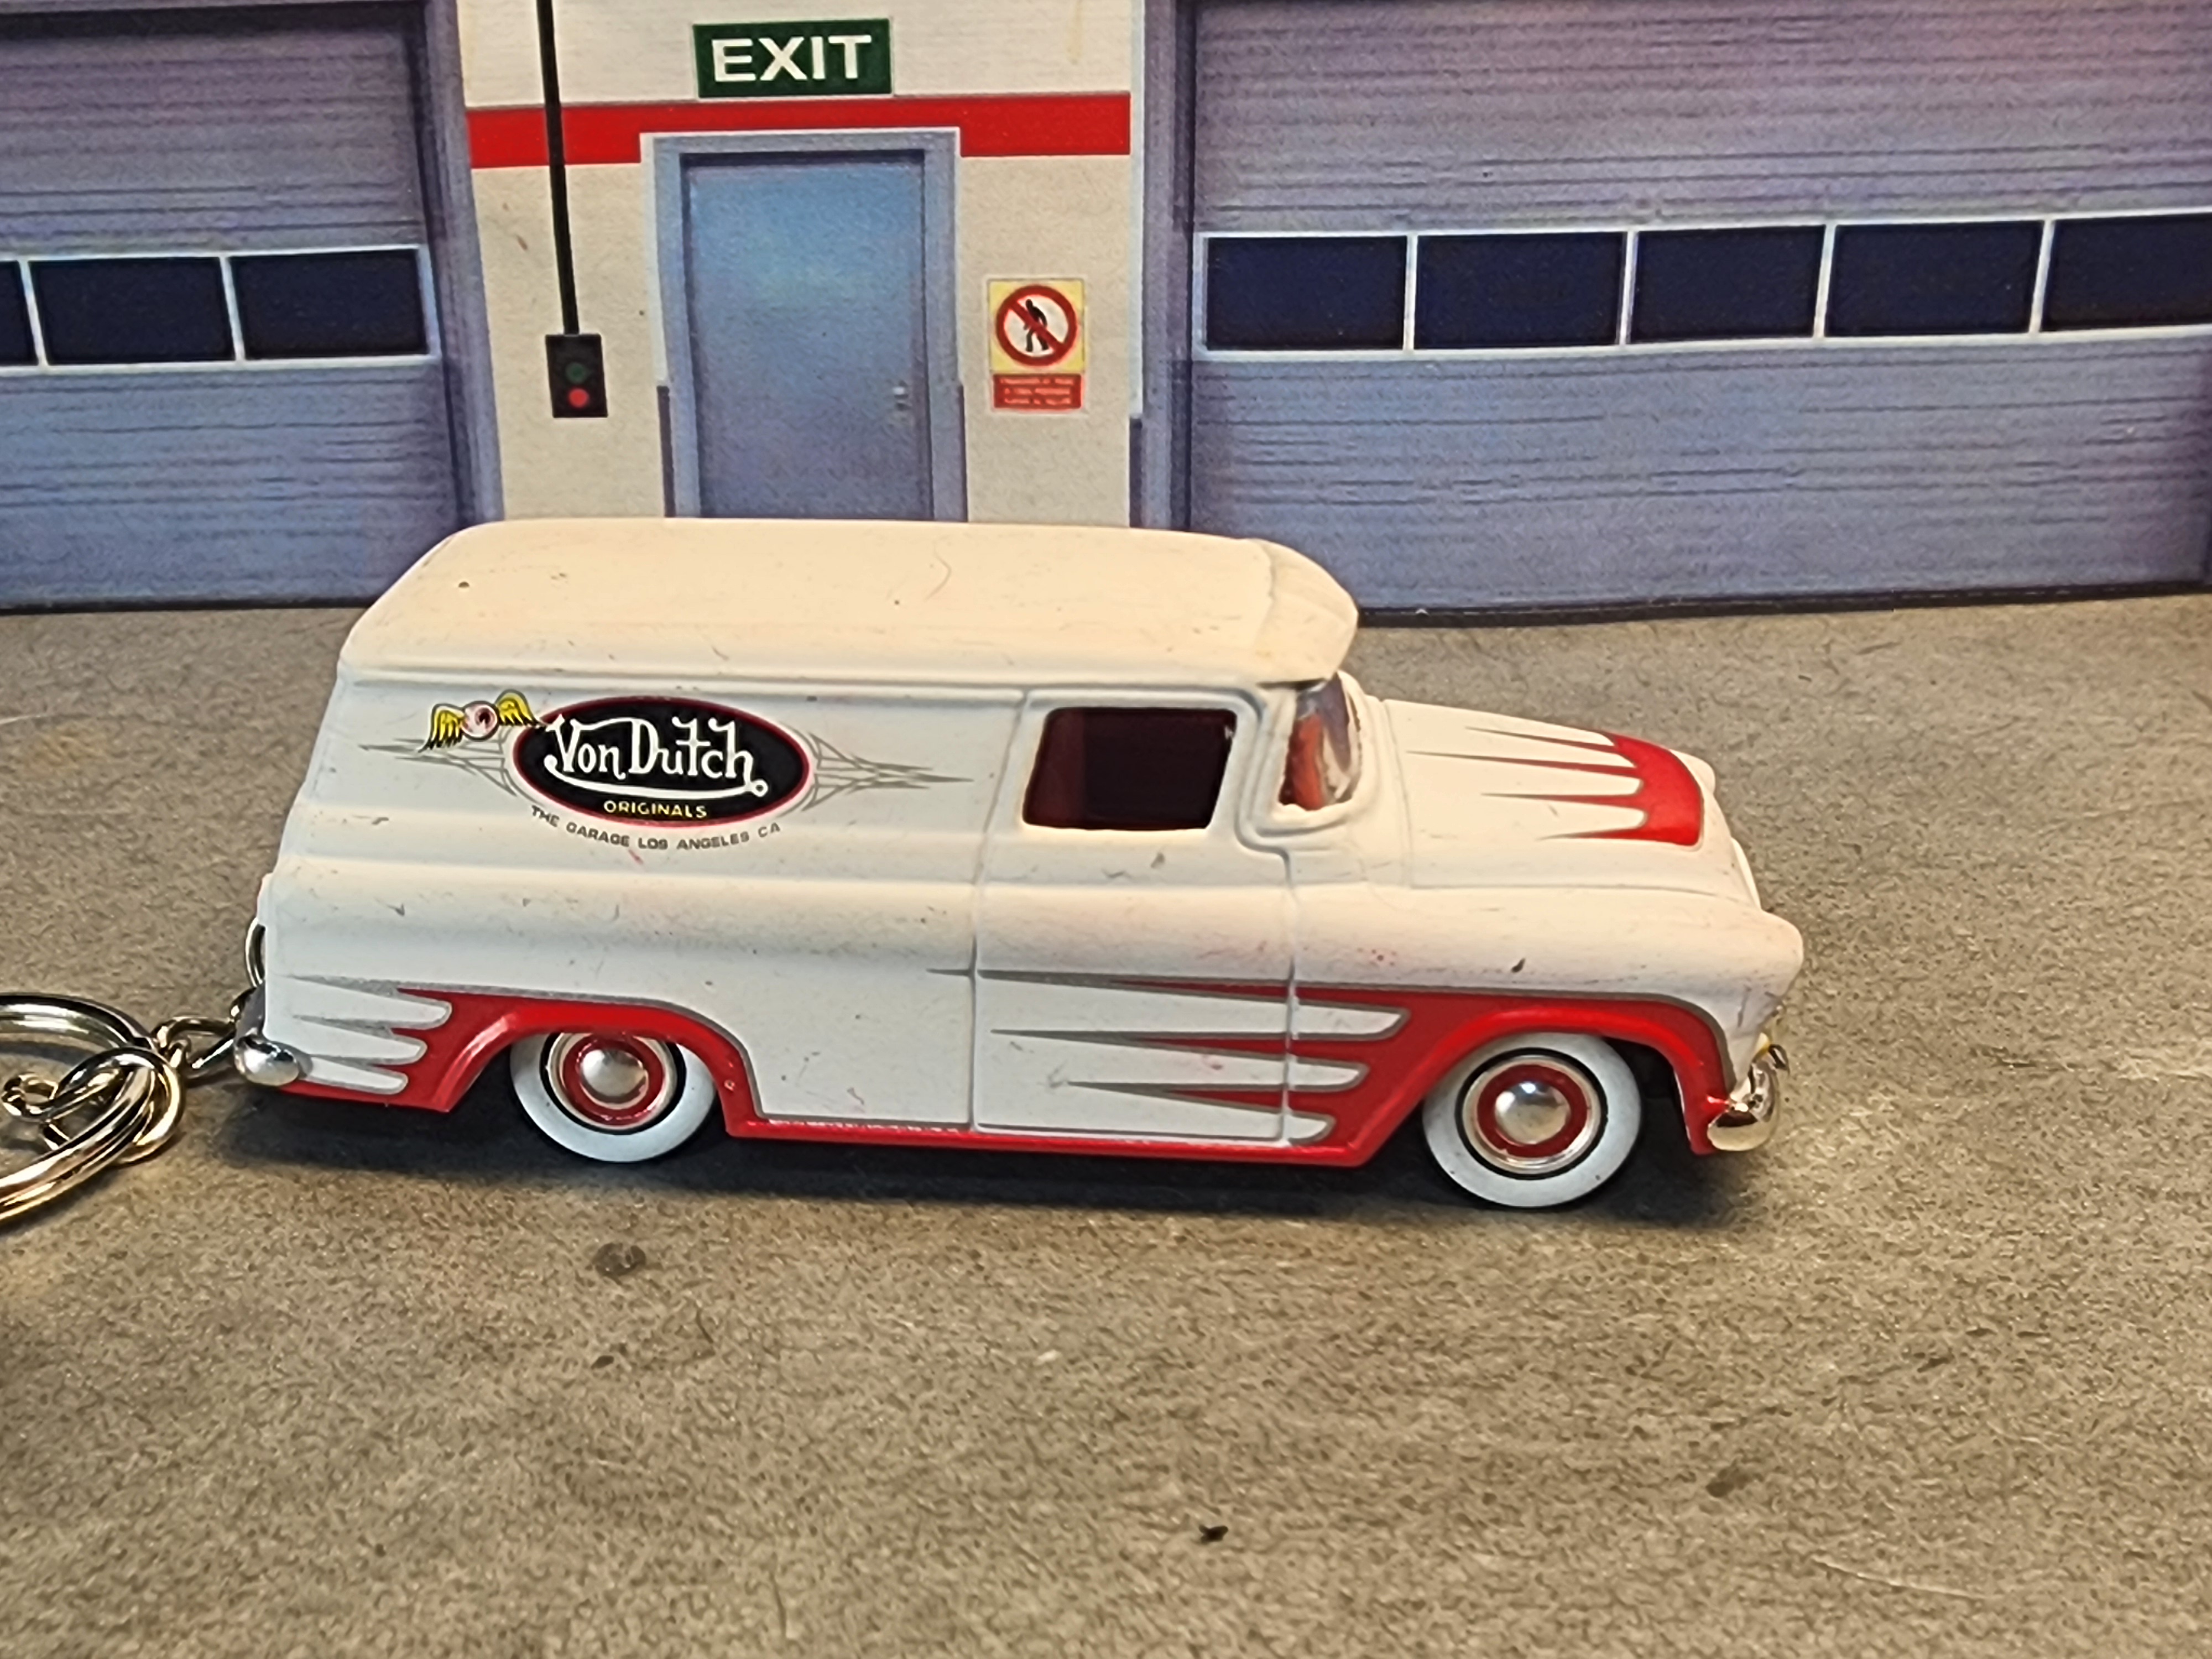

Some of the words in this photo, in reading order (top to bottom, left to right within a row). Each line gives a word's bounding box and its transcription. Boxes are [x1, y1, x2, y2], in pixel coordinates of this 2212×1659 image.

[711, 34, 872, 82] EXIT
[545, 714, 627, 780] Von
[628, 716, 762, 791] Dutch
[531, 805, 560, 828] THE
[566, 821, 630, 847] GARAGE
[638, 837, 669, 850] LOS
[676, 831, 750, 850] ANGELES
[758, 822, 781, 838] CA
[603, 800, 707, 818] ORIGINALS
